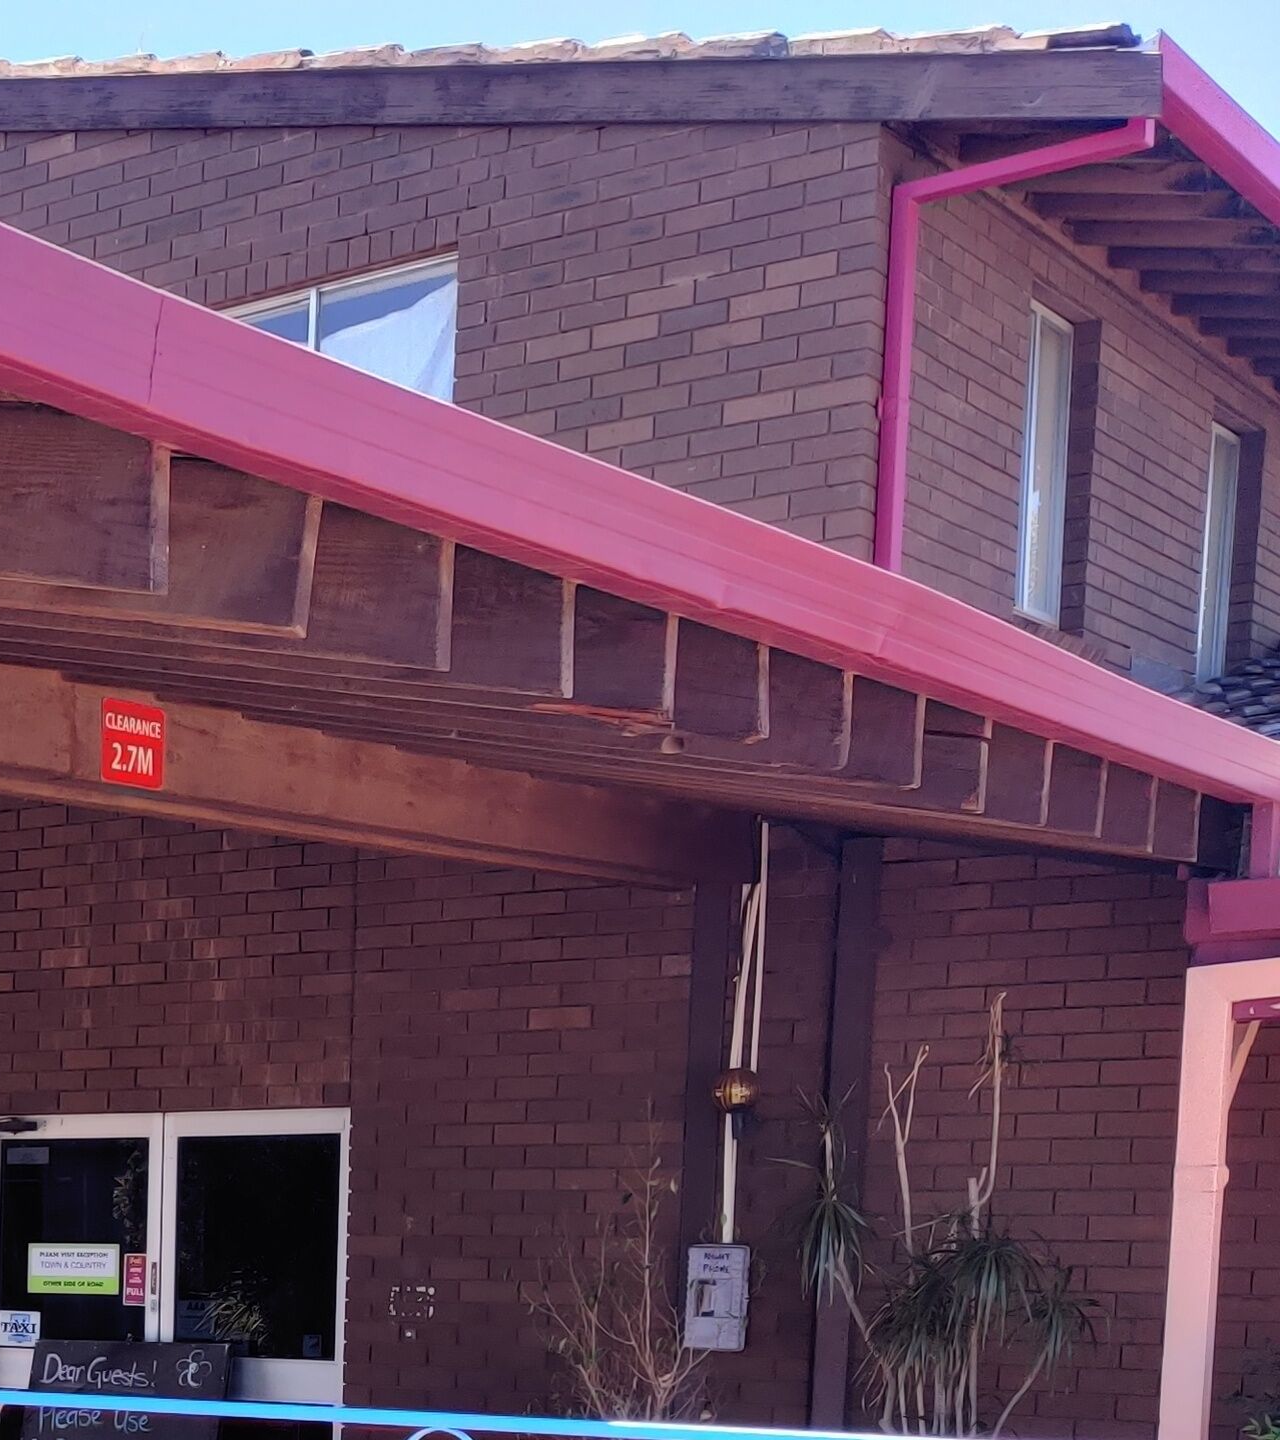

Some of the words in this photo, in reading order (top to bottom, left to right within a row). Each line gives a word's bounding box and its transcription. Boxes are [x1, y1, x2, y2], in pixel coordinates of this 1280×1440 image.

[105, 712, 162, 739] CLEARANCE
[111, 742, 154, 777] 2.7M
[41, 1261, 62, 1269] TOWN
[70, 1261, 107, 1269] COUNTRY
[126, 1287, 144, 1297] PULL
[1, 1321, 37, 1334] TAXI
[40, 1353, 86, 1385] Dear
[87, 1357, 158, 1389] Guests!
